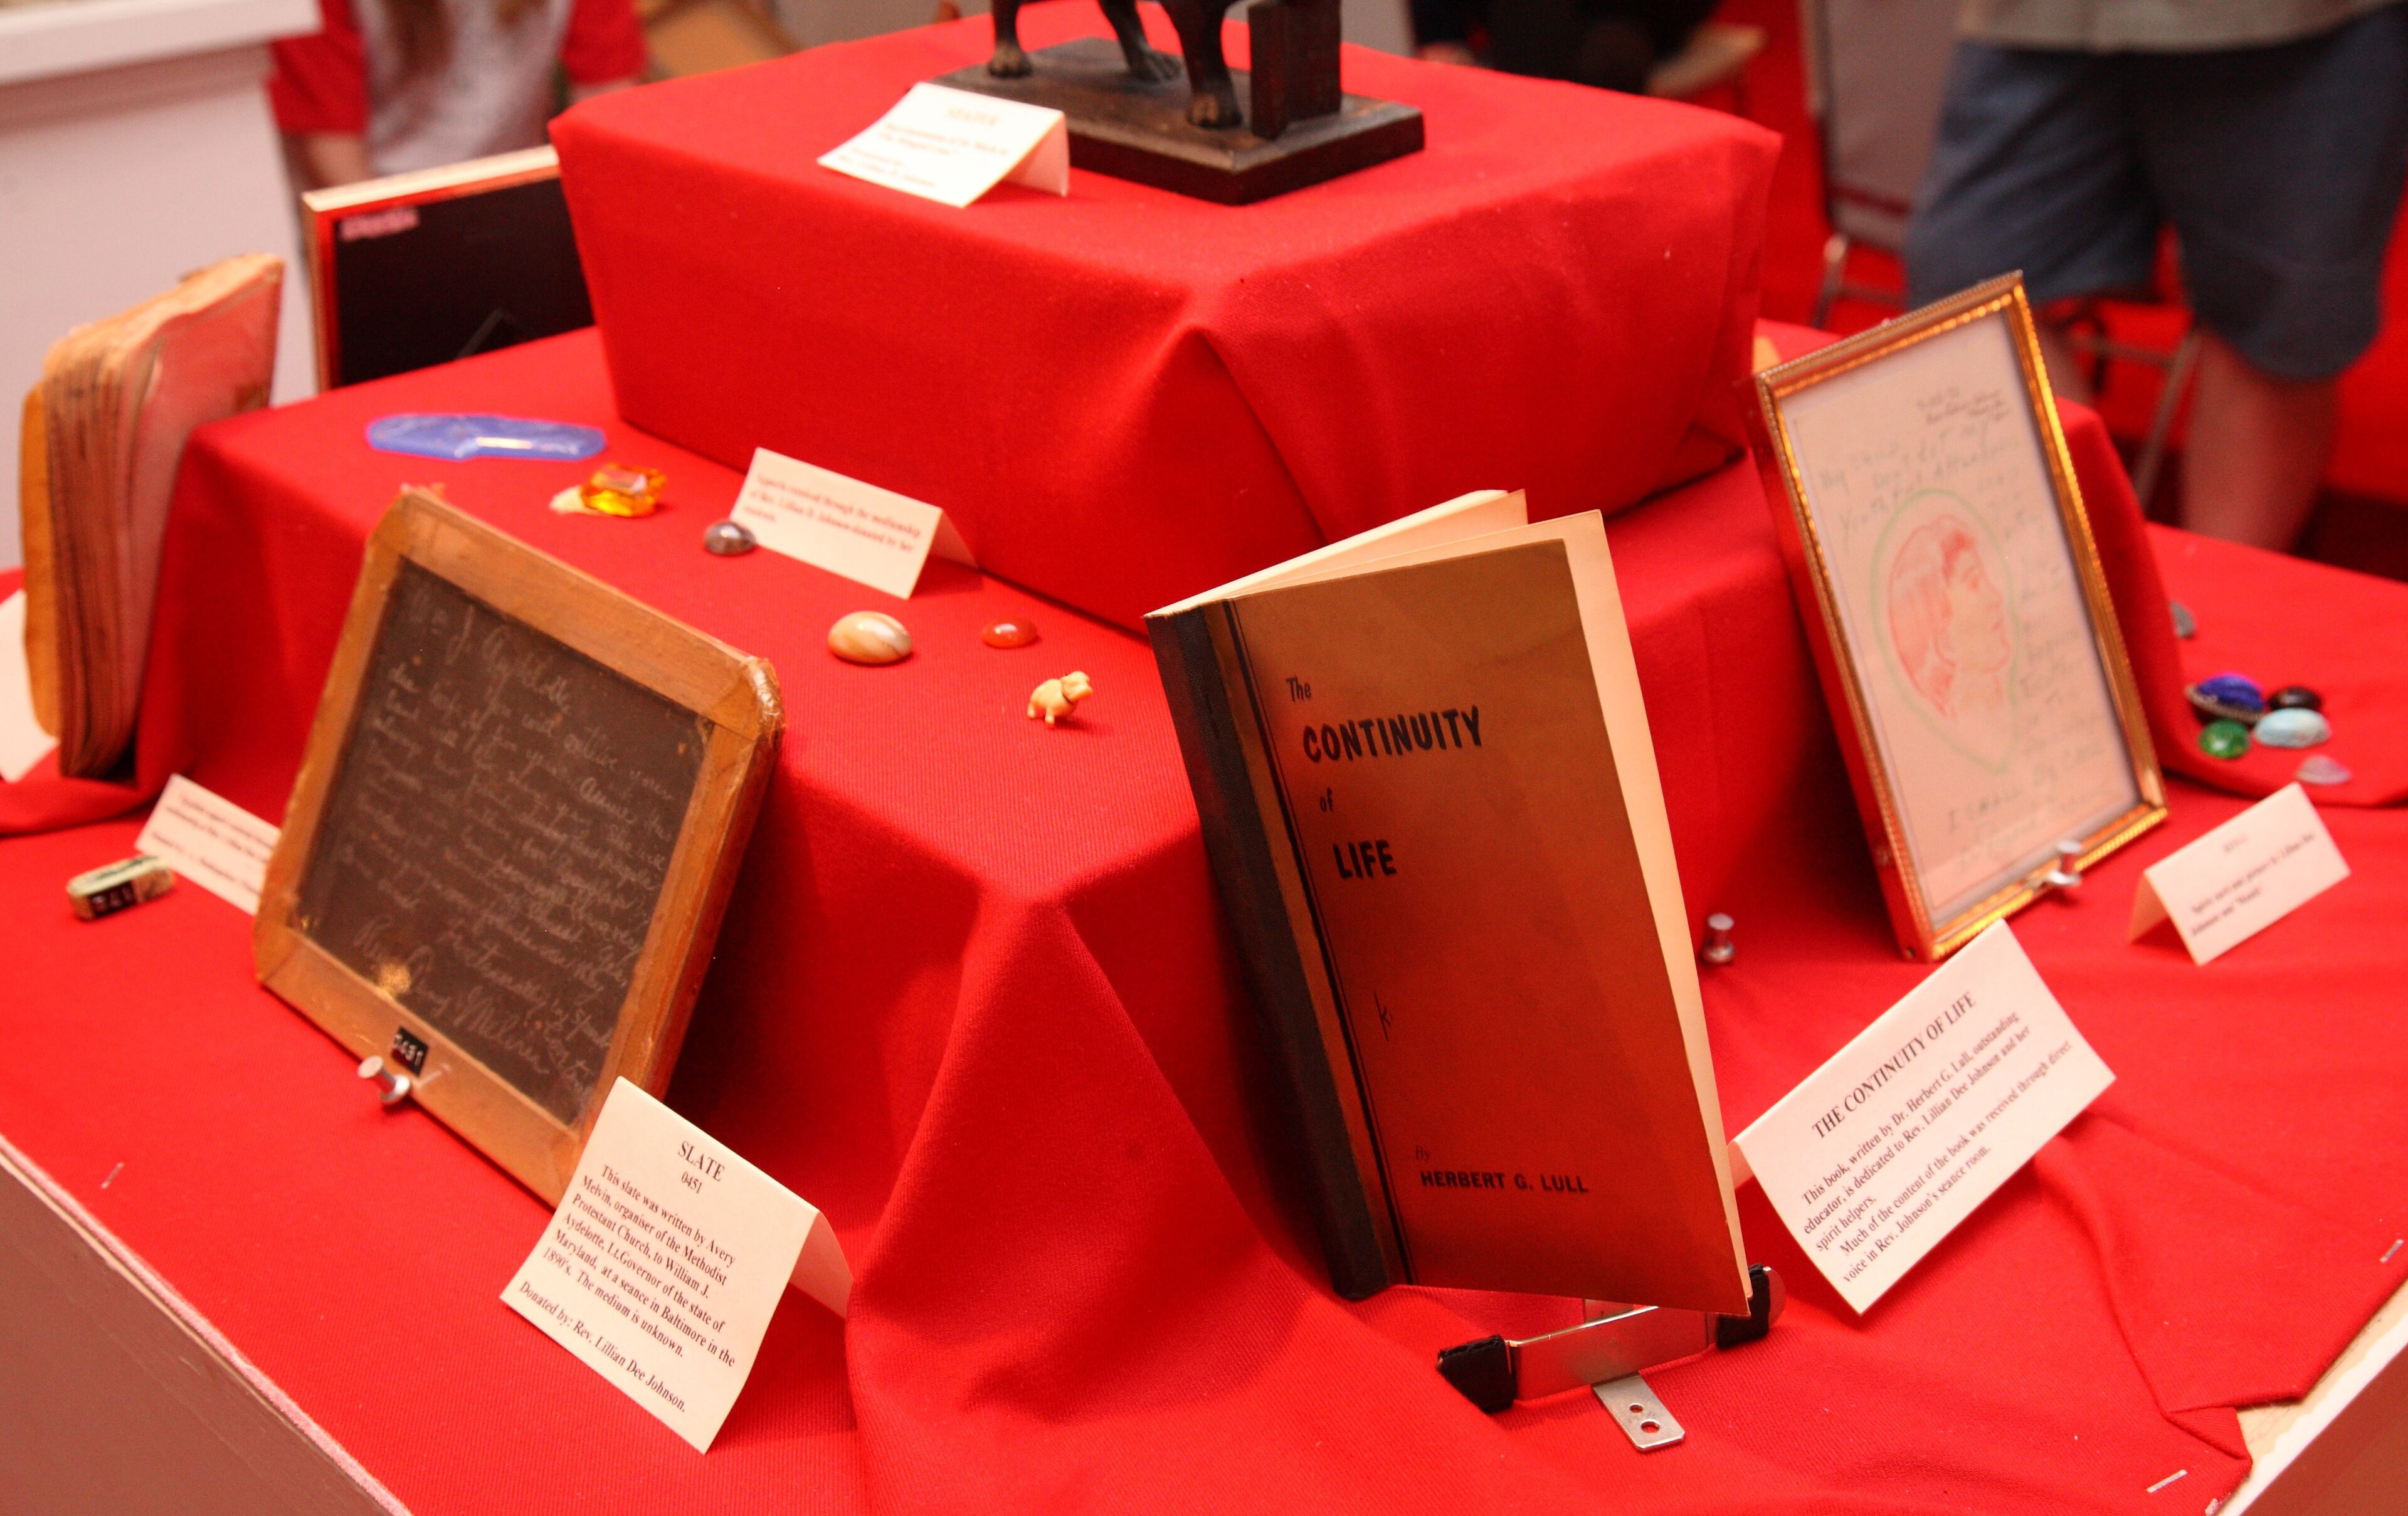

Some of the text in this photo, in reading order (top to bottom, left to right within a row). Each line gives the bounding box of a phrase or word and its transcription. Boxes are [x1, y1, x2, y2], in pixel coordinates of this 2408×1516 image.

[1286, 676, 1312, 703] The
[1302, 704, 1482, 763] CONTINUITY
[1319, 787, 1333, 812] of
[1333, 839, 1398, 880] LIFE
[1802, 1012, 2020, 1205] This book, written by Dr. Herbert G. Lull, outstanding
[1812, 992, 1975, 1138] THE CONTINUITY OF LIFE
[679, 1142, 724, 1181] SLATE
[682, 1171, 702, 1194] 0451
[1420, 1171, 1590, 1193] HERBERT G. LULL
[1804, 1026, 2030, 1234] educator, is dedicated to Rev. Lillian Dee Johnson and her
[1840, 1041, 2072, 1255] Much of the content of the book was received through direct
[573, 1193, 709, 1298] Protestant Church, to William J.
[584, 1175, 727, 1285] Melvin, organiser of the Methodist
[602, 1165, 735, 1268] This slate was written by Avery
[1816, 1196, 1876, 1251] spirit helpers.
[1843, 1147, 1990, 1282] voice in Rev. Johnson's seance room.
[543, 1248, 682, 1357] 1890's. The medium is unknown.
[556, 1229, 734, 1367] Maryland, at a seance in Baltimore in the
[565, 1213, 604, 1250] Aydelotte,
[663, 1285, 675, 1296] of
[673, 1291, 688, 1307] the
[689, 1304, 711, 1324] state
[713, 1321, 726, 1332] of
[519, 1281, 685, 1412] Donated by: Rev. Lillian Dee Johnson.
